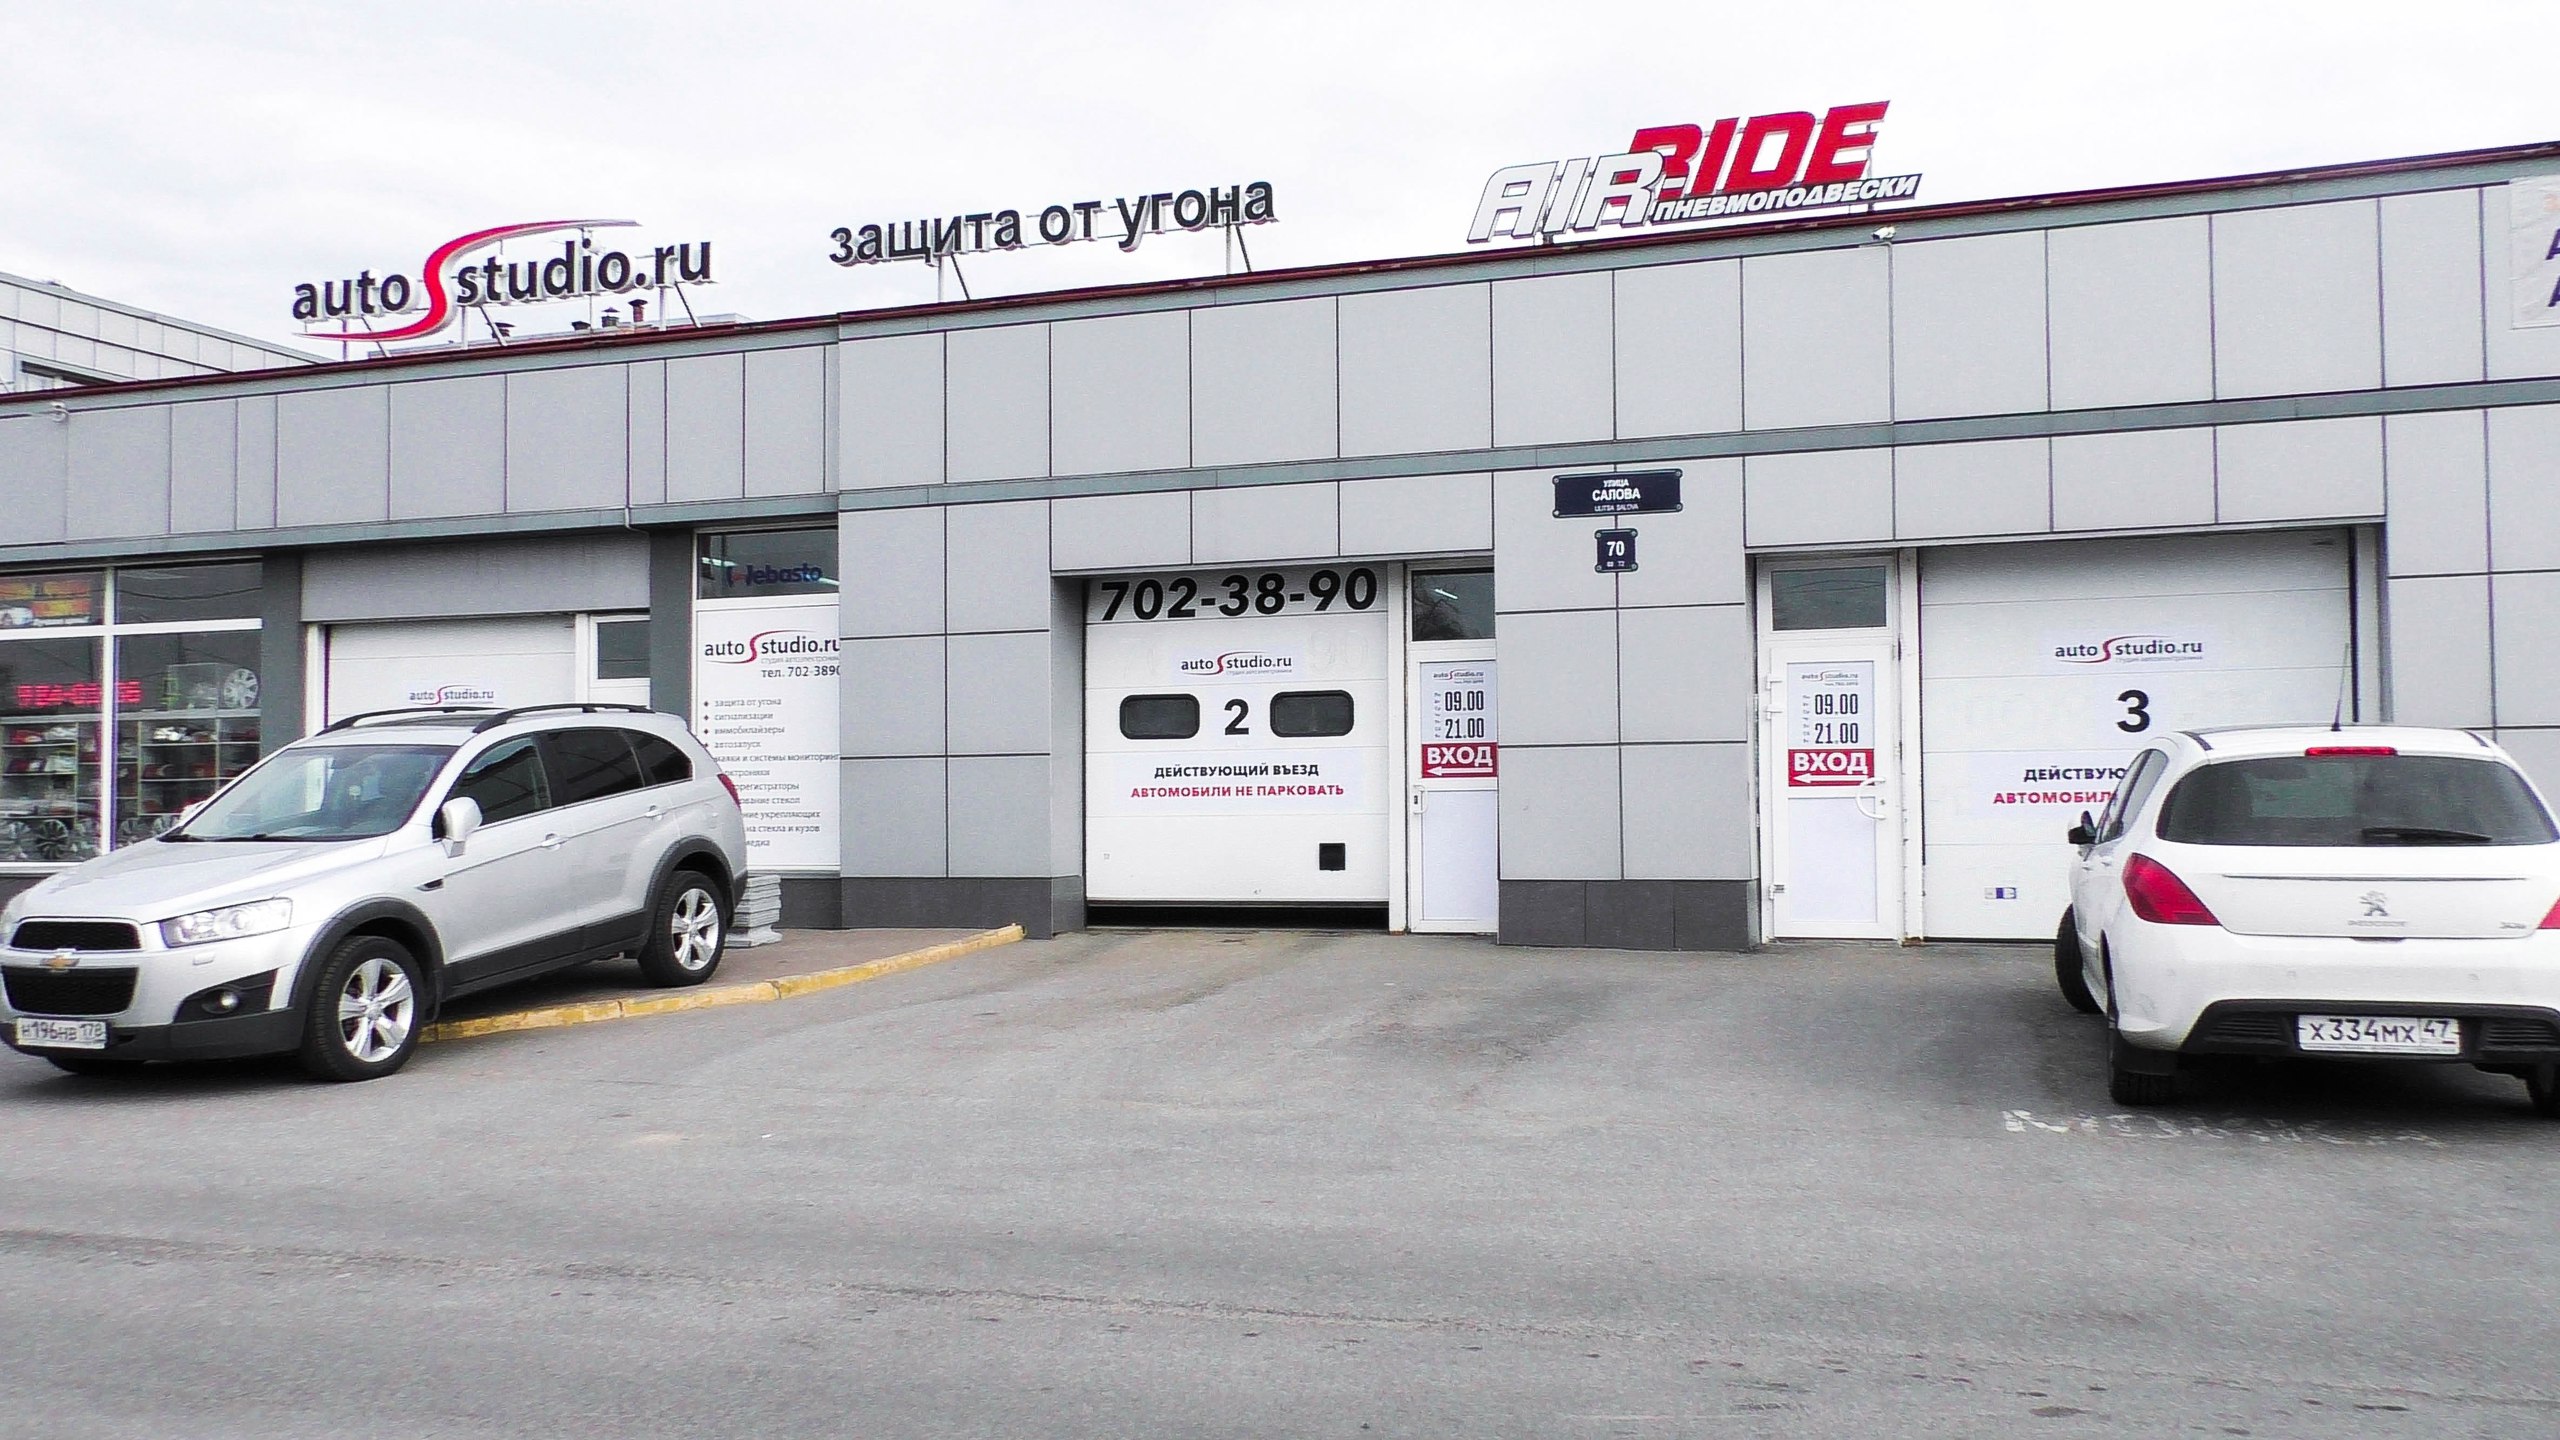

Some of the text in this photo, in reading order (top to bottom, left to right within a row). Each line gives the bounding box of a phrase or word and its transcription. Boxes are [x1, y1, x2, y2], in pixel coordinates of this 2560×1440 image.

[1466, 150, 1665, 243] AIR
[1653, 175, 1920, 221] ПНЕВМОПОДВЕСКИ
[829, 181, 1275, 267] защита от угона
[1592, 488, 1641, 501] САЛОВА
[1607, 540, 1625, 556] 70
[1101, 567, 1378, 622] 702-38-90
[1445, 691, 1484, 711] 09.00
[1815, 693, 1858, 715] 09.00
[2116, 689, 2150, 733] 3
[1224, 699, 1250, 735] 2
[1445, 718, 1484, 739] 21.00
[1815, 723, 1858, 744] 21.00
[1427, 746, 1493, 767] ВХОД
[1794, 752, 1868, 774] ВХОД
[1154, 763, 1319, 778] ДЕЙСТВУЮЩИЙ ВЪЕЗД
[2024, 765, 2127, 782] ДЕЙСТВУЮ
[1131, 785, 1345, 798] АВТОМОБИЛИ НЕ ПАРКОВАТЬ
